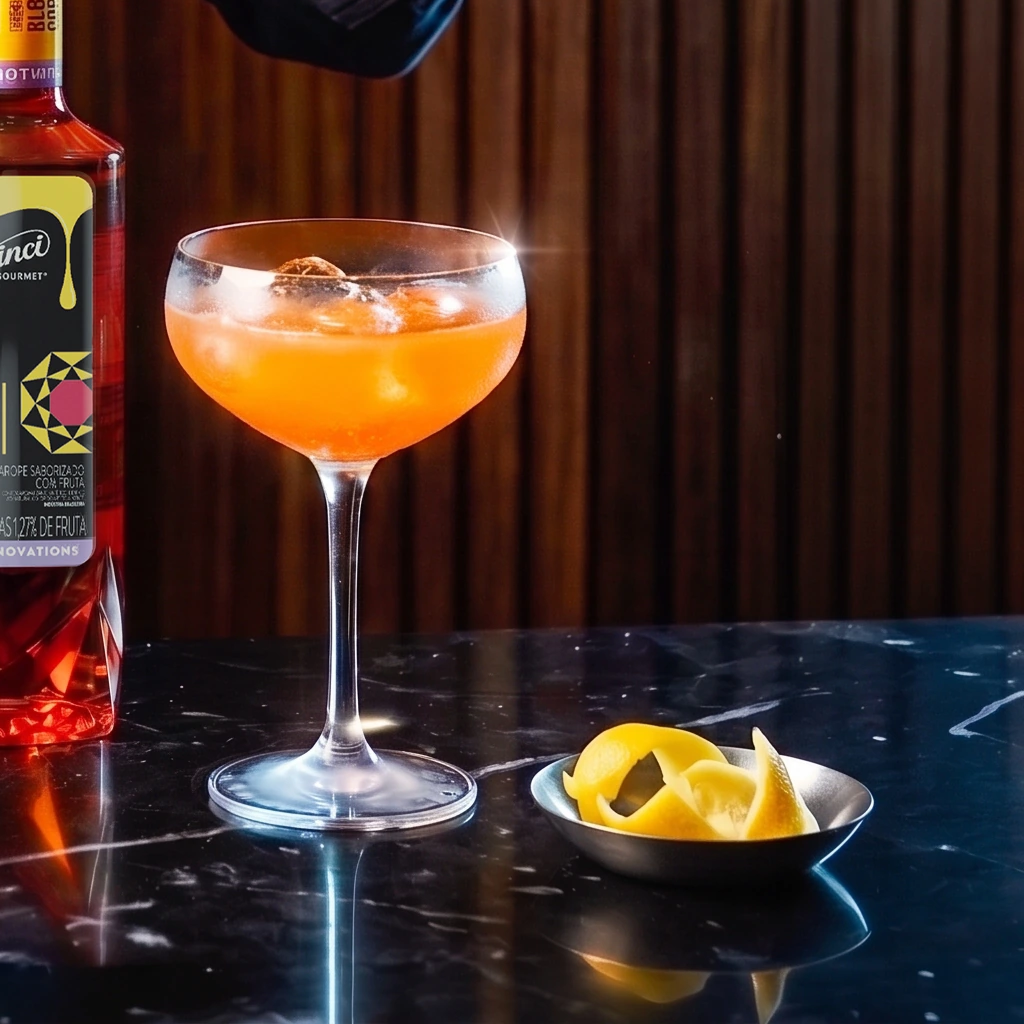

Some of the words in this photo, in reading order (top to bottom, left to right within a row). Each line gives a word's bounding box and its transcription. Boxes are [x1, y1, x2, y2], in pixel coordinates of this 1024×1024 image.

[30, 465, 85, 476] SABORIZADO
[59, 477, 85, 489] FRUTA
[40, 516, 54, 537] DE
[56, 516, 87, 537] FRUTA
